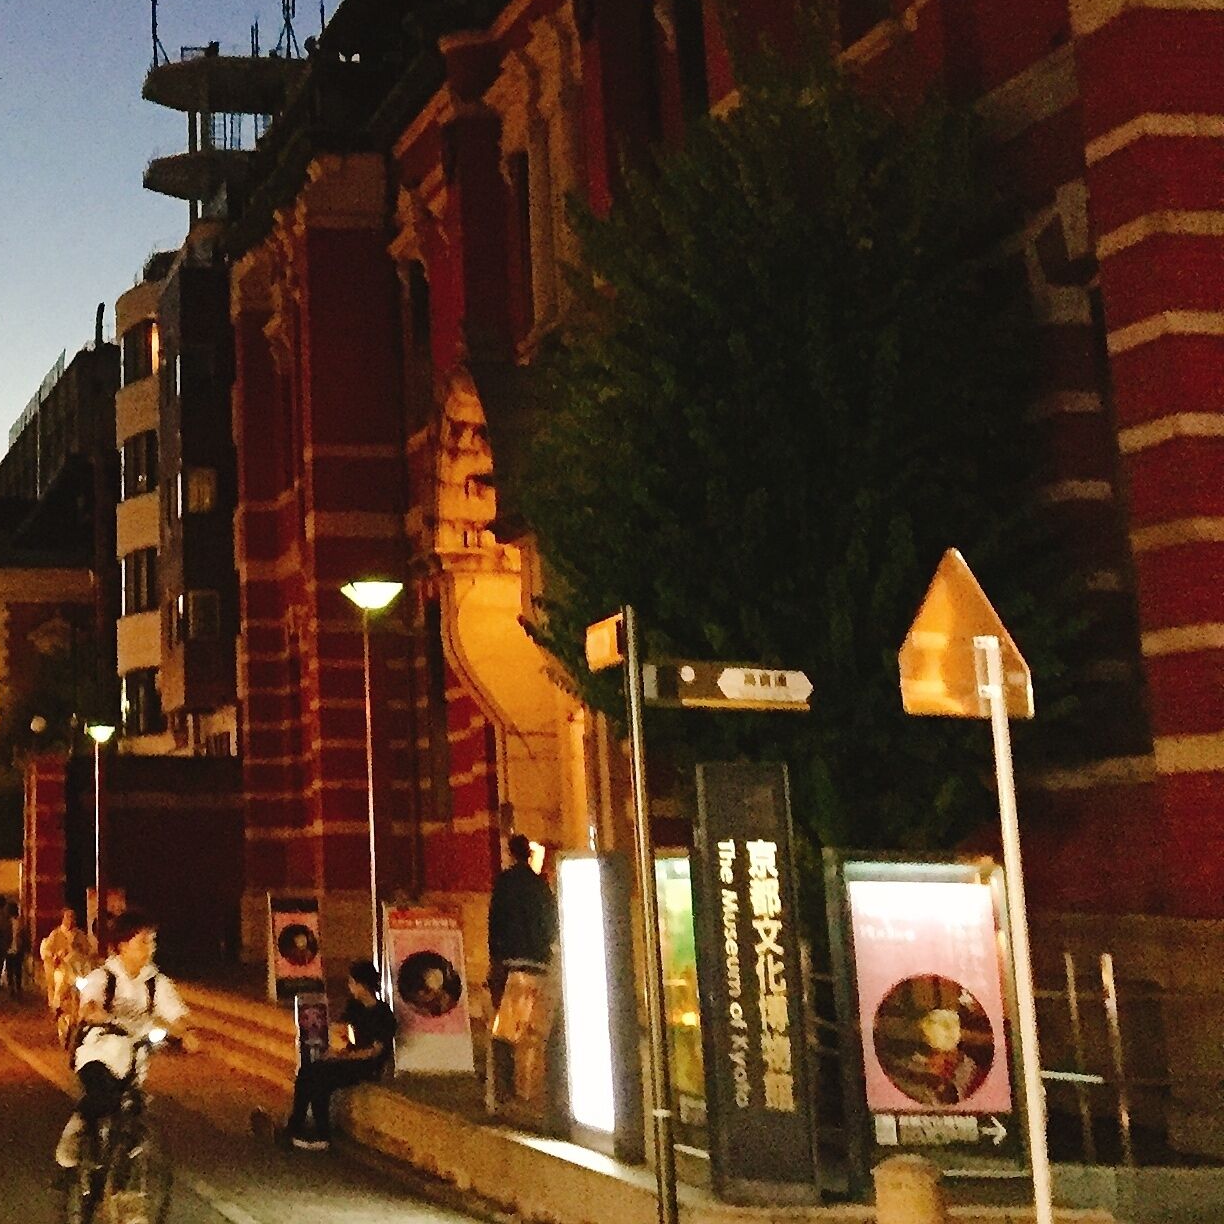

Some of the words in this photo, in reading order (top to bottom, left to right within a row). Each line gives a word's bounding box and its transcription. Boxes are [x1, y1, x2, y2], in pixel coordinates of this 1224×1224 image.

[718, 839, 736, 884] The
[722, 889, 741, 998] Museum
[730, 1002, 747, 1028] of
[729, 1033, 751, 1109] Kyoto
